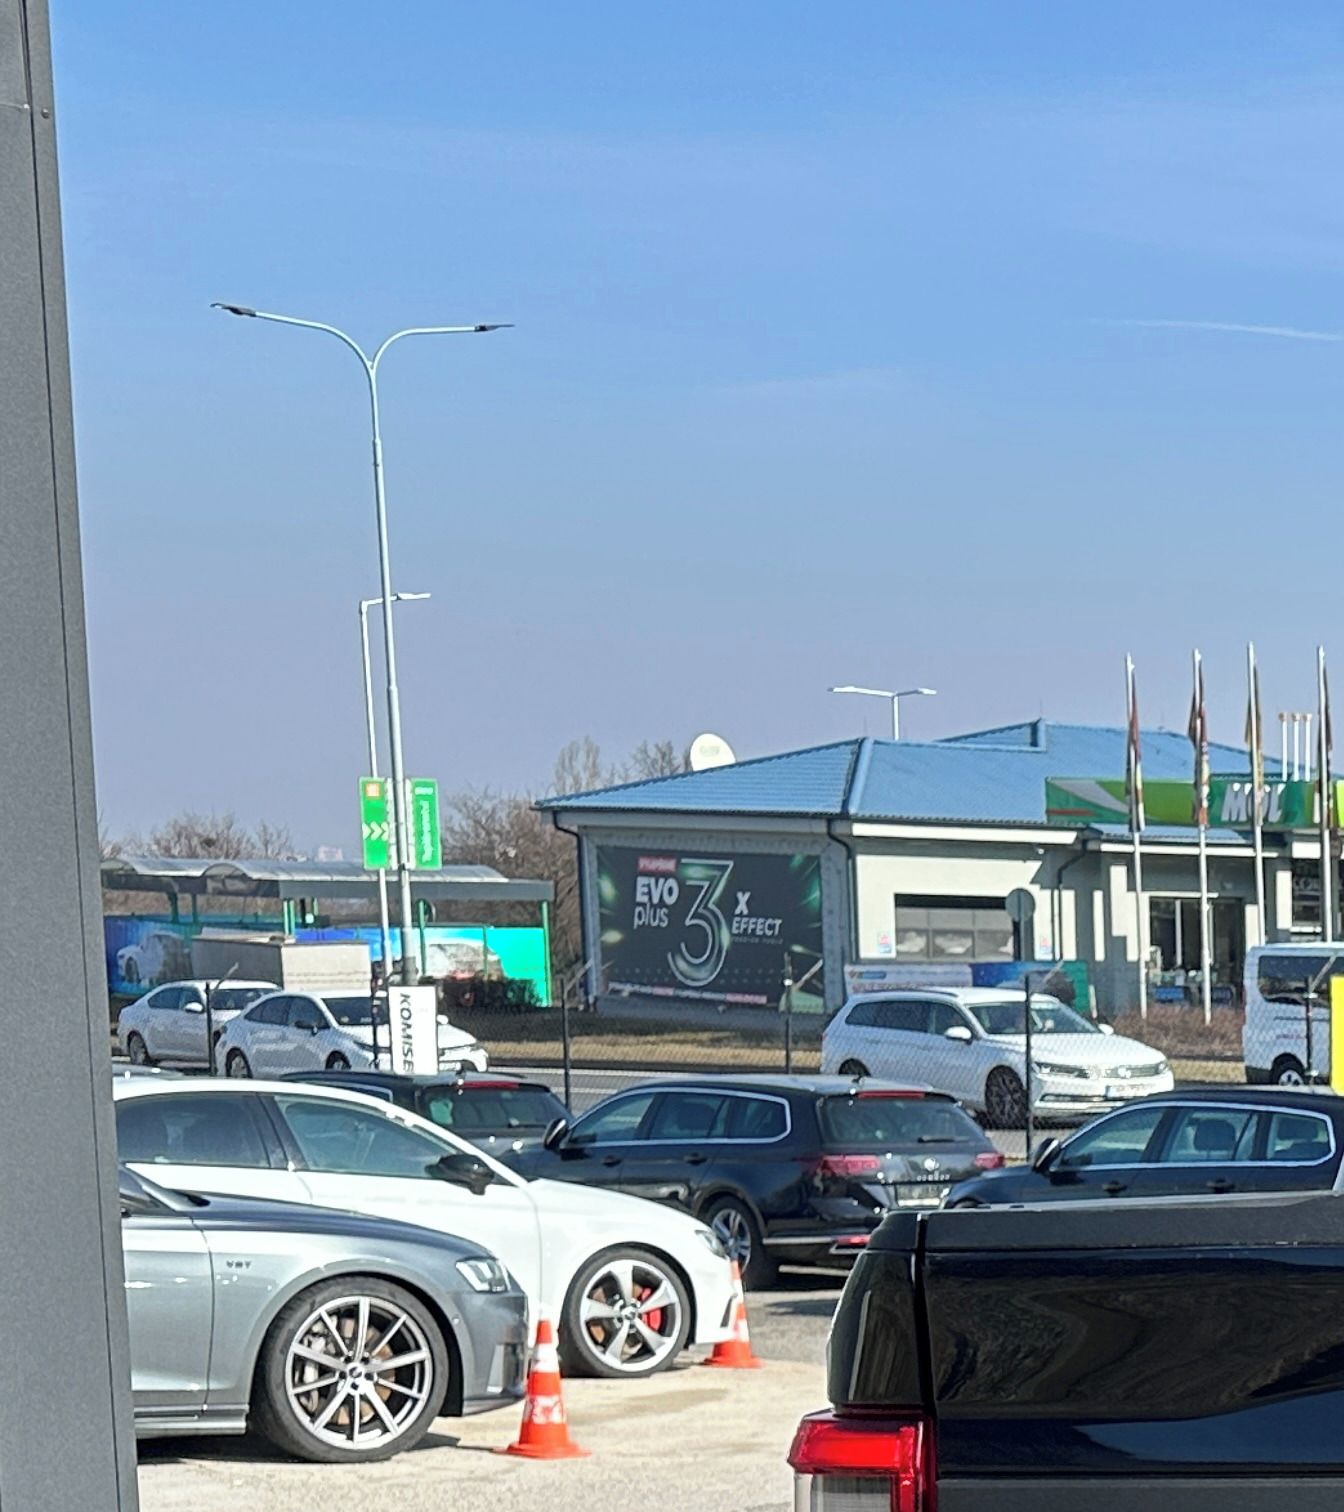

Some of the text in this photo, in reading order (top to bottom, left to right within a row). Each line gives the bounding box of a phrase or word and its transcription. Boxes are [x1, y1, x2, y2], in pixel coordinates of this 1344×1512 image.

[635, 876, 679, 904] EVO
[633, 902, 669, 929] plus
[667, 858, 734, 986] 3
[731, 917, 783, 935] EFFECT
[400, 992, 415, 1073] KOMISE
